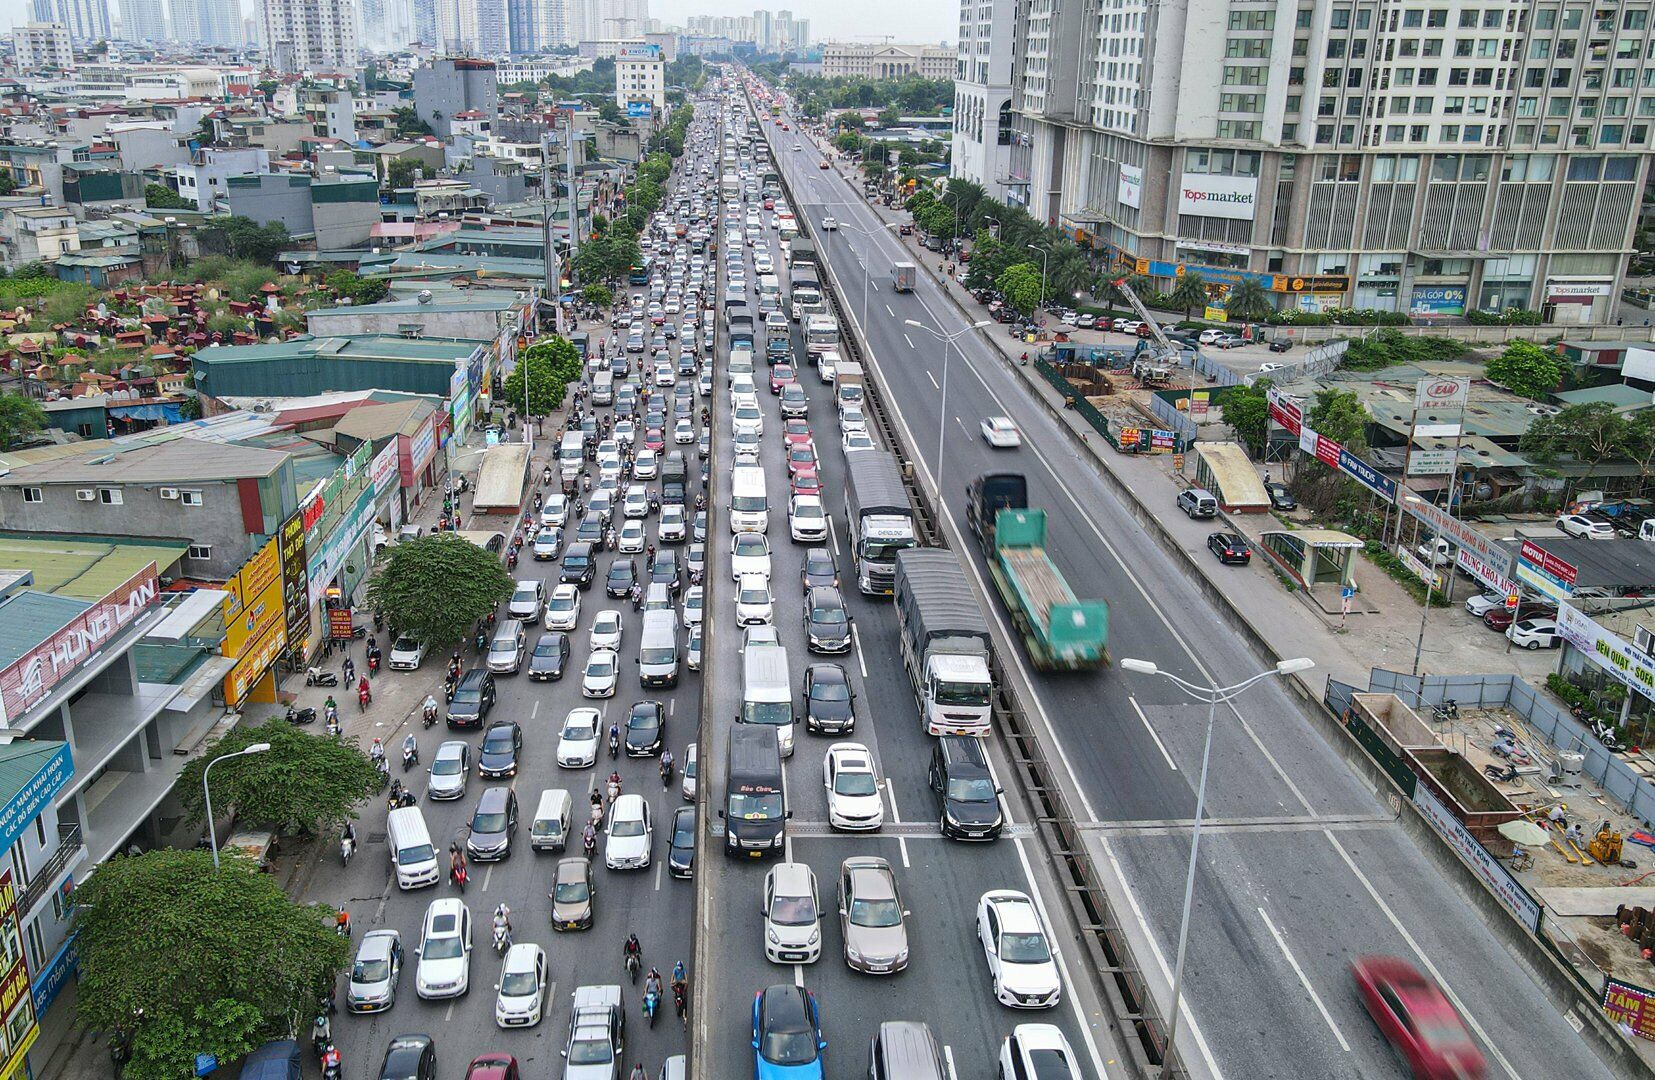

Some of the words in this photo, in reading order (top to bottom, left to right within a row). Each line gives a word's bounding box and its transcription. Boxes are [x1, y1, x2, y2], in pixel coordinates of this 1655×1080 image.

[1427, 289, 1443, 300] GÓP
[1444, 290, 1463, 300] 0%
[1153, 430, 1174, 438] 280
[1522, 544, 1543, 562] MOTUL
[1481, 563, 1499, 586] KHOA
[1499, 576, 1518, 597] AUTO
[50, 612, 111, 674] HÙNG
[114, 578, 155, 625] LAN
[1610, 649, 1630, 671] QUẠT
[1634, 665, 1653, 687] SOFA
[5, 821, 18, 838] CÁC
[40, 782, 52, 799] CAO
